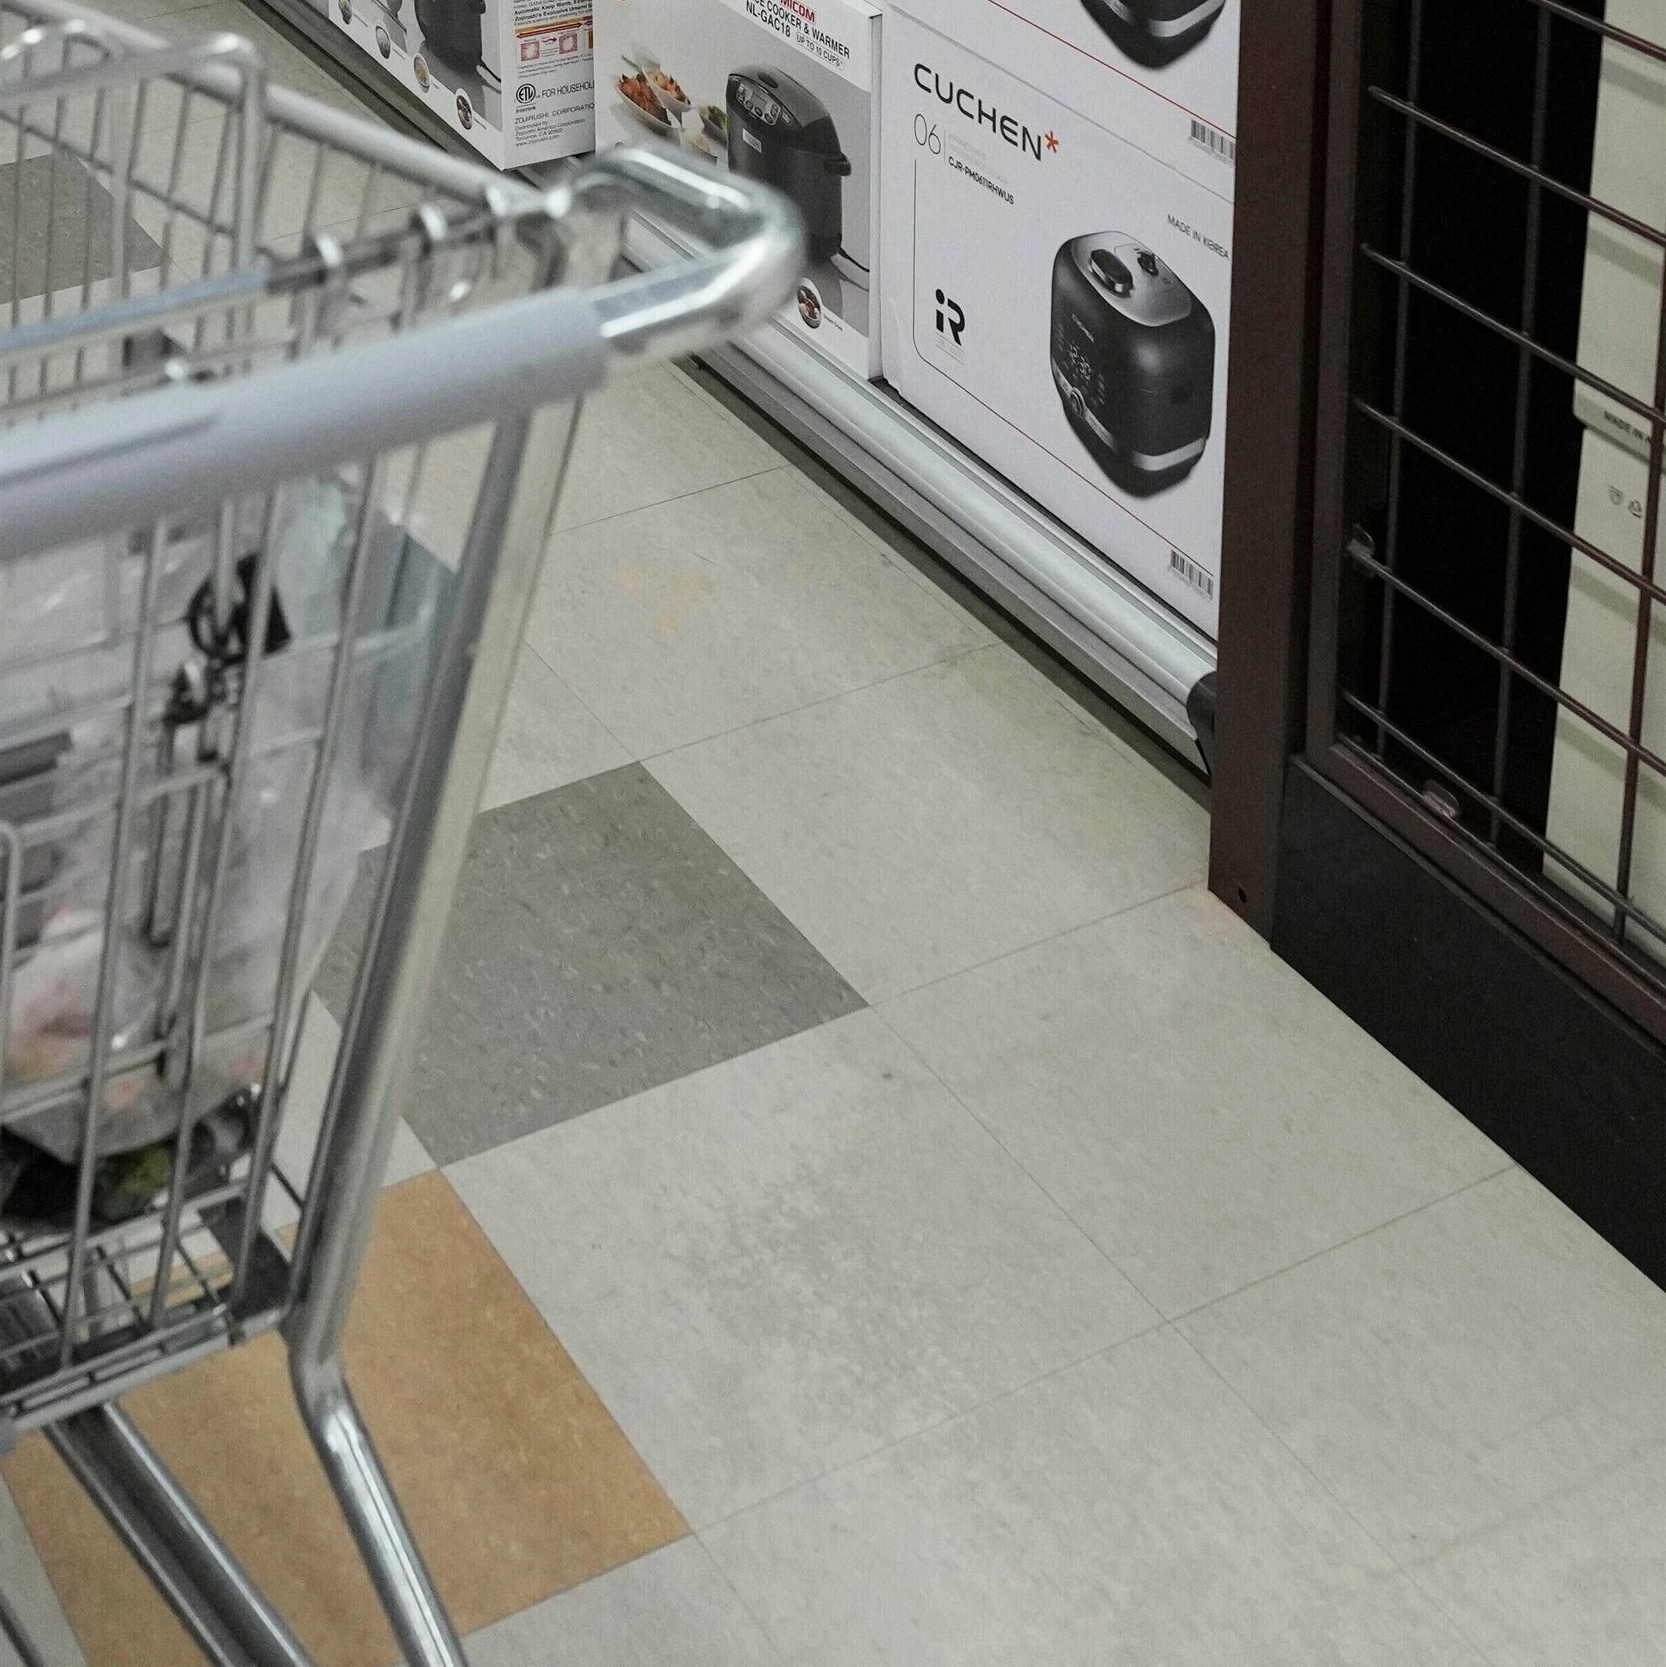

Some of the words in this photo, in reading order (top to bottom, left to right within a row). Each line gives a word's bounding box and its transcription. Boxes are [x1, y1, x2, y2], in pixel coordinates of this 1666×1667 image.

[745, 1, 791, 38] NL-GAC18
[811, 25, 851, 60] WARMER
[914, 62, 1042, 161] CUCHEN
[914, 113, 942, 156] 06
[1167, 214, 1190, 235] MADE
